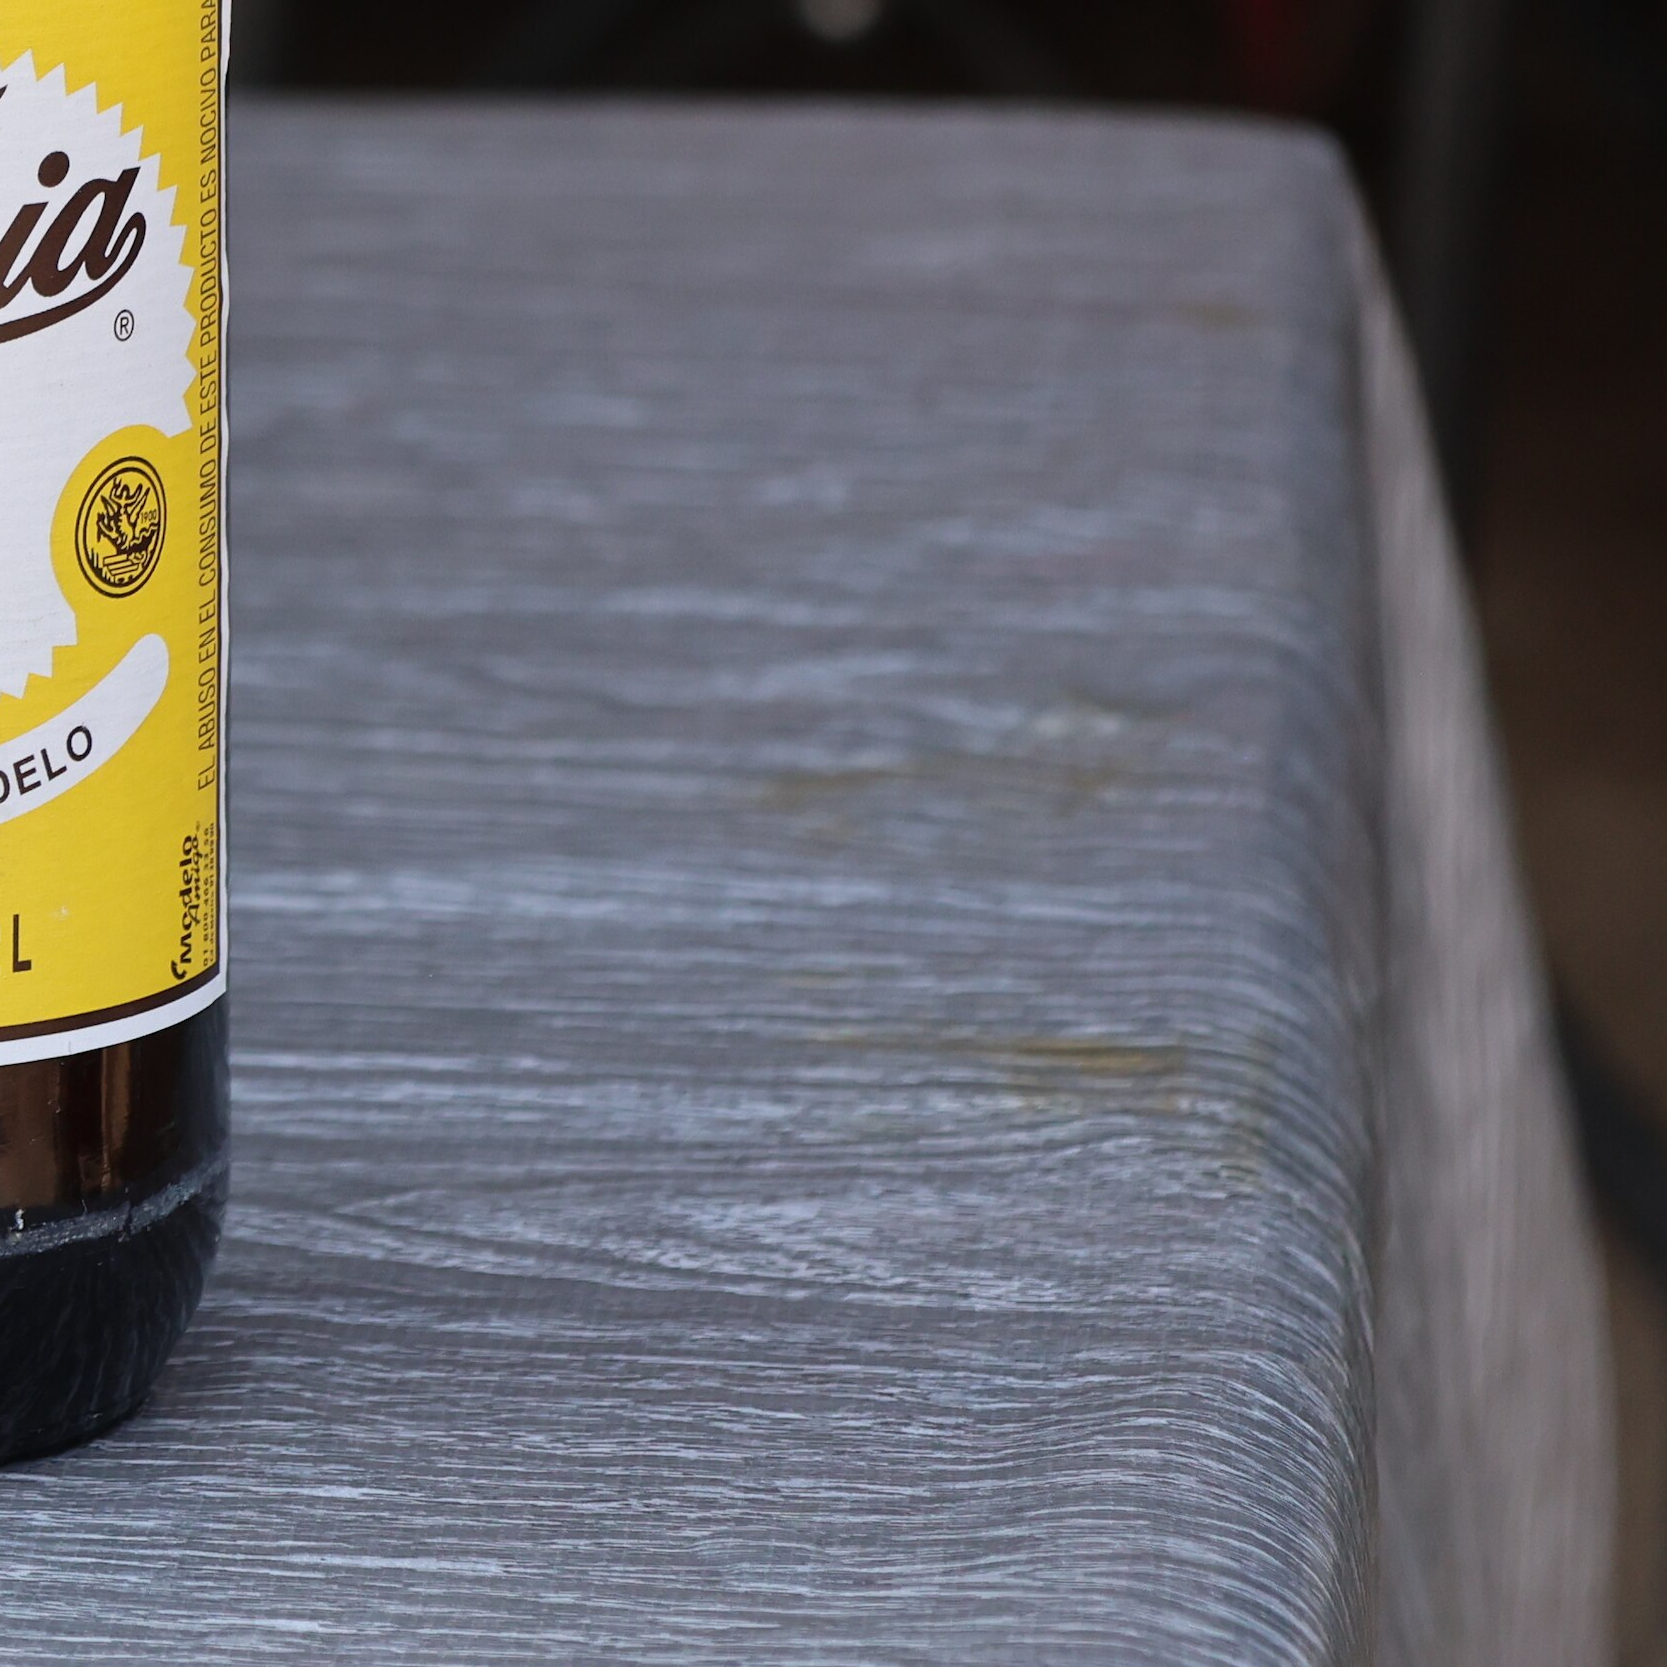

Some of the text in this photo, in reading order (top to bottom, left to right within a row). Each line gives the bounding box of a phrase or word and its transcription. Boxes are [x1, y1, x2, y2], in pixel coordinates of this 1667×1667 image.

[200, 68, 216, 164] NOCIVO
[200, 170, 216, 204] ES
[200, 209, 216, 347] PRODUCTO
[200, 350, 216, 415] ESTE
[200, 418, 216, 454] DE
[199, 459, 216, 587] CONSUMO
[199, 590, 216, 621] EL
[198, 627, 216, 664] EN
[198, 668, 216, 751] ABUSO
[198, 755, 216, 791] EL
[179, 835, 192, 964] Modelo
[187, 834, 202, 926] Amigo
[13, 913, 32, 972] L
